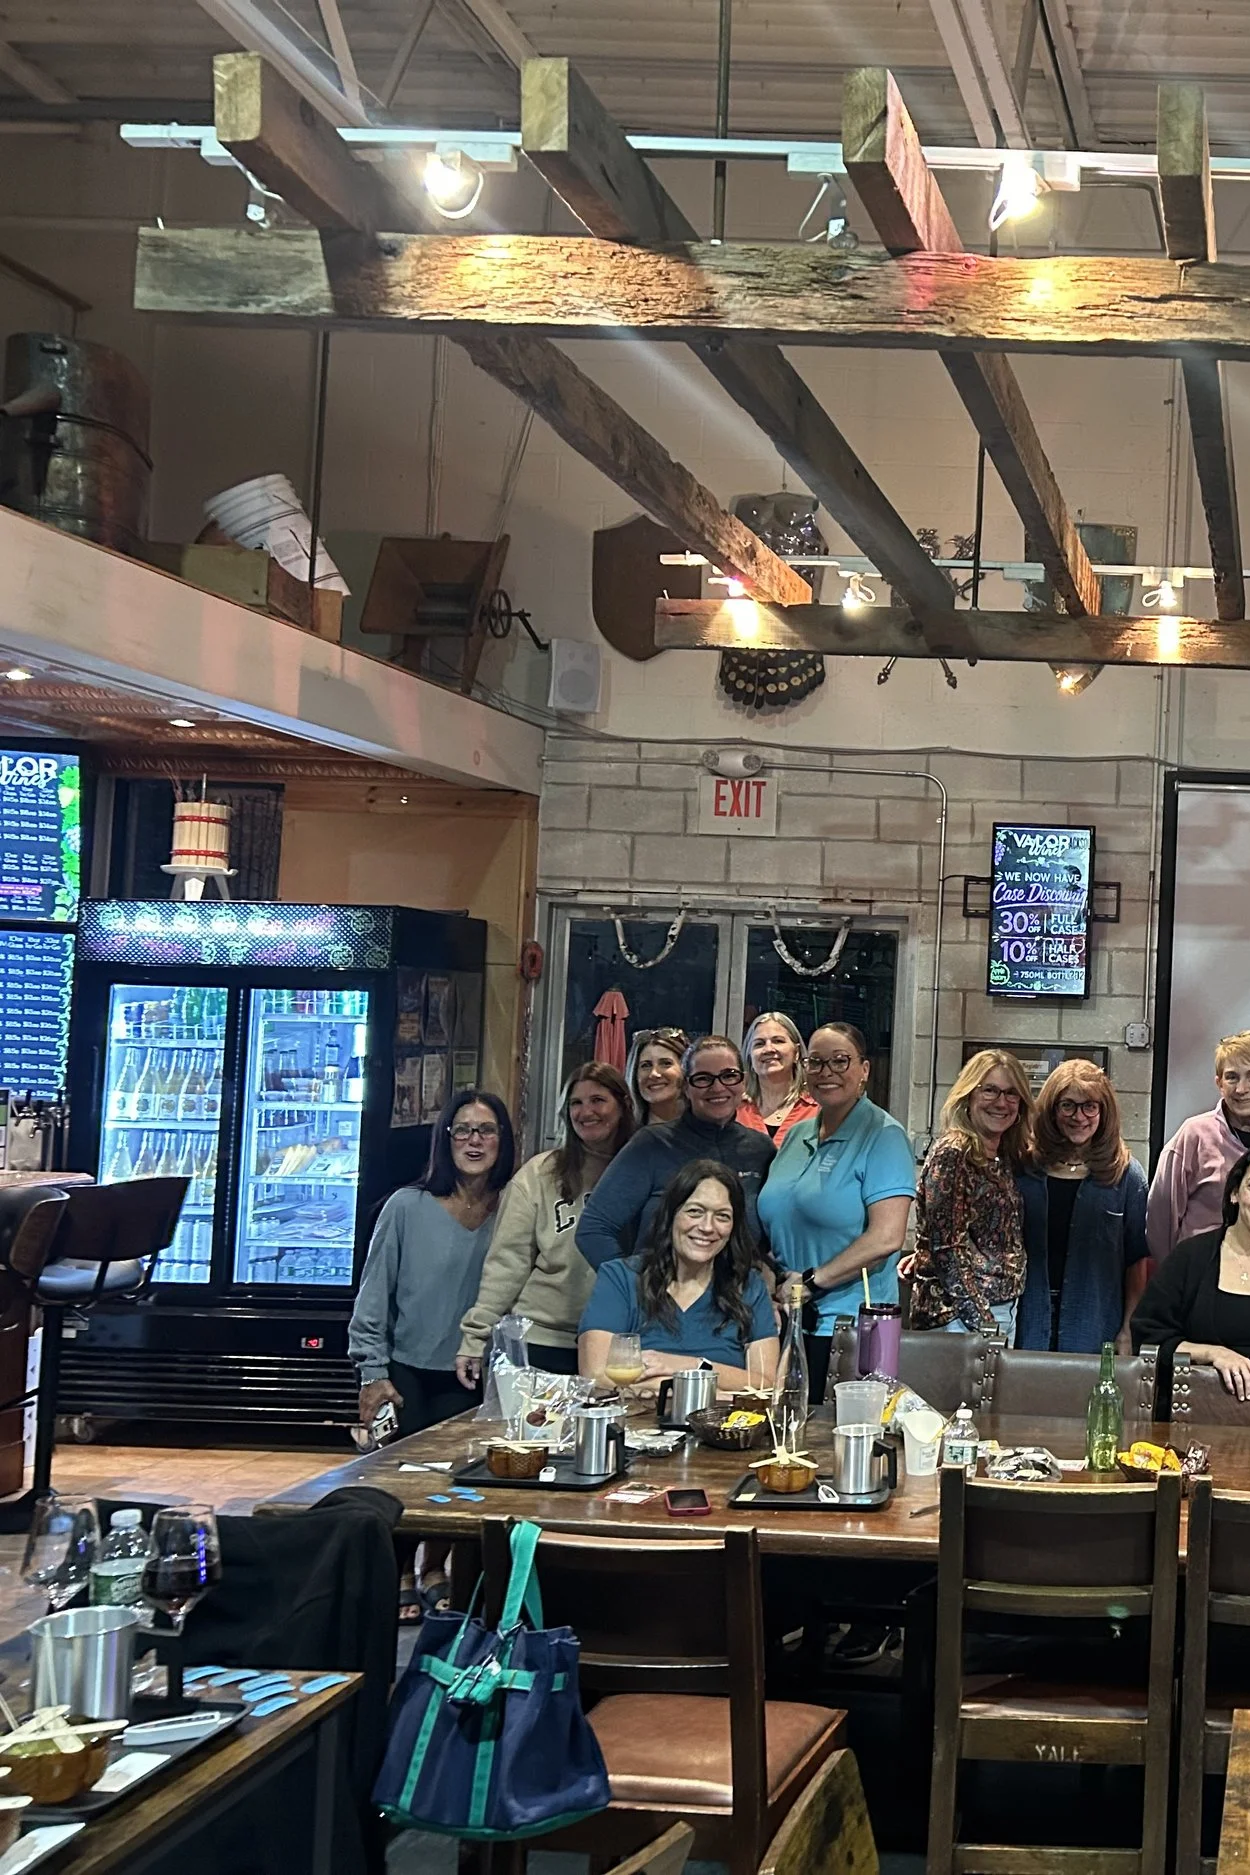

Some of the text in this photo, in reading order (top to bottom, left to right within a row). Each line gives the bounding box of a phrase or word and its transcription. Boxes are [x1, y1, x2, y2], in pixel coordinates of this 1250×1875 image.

[0, 755, 58, 779] LOR
[714, 780, 767, 817] EXIT
[1004, 872, 1081, 884] WE NOW HAVE
[993, 882, 1026, 904] Case
[1051, 913, 1077, 924] FULL
[1020, 971, 1045, 979] 750ML
